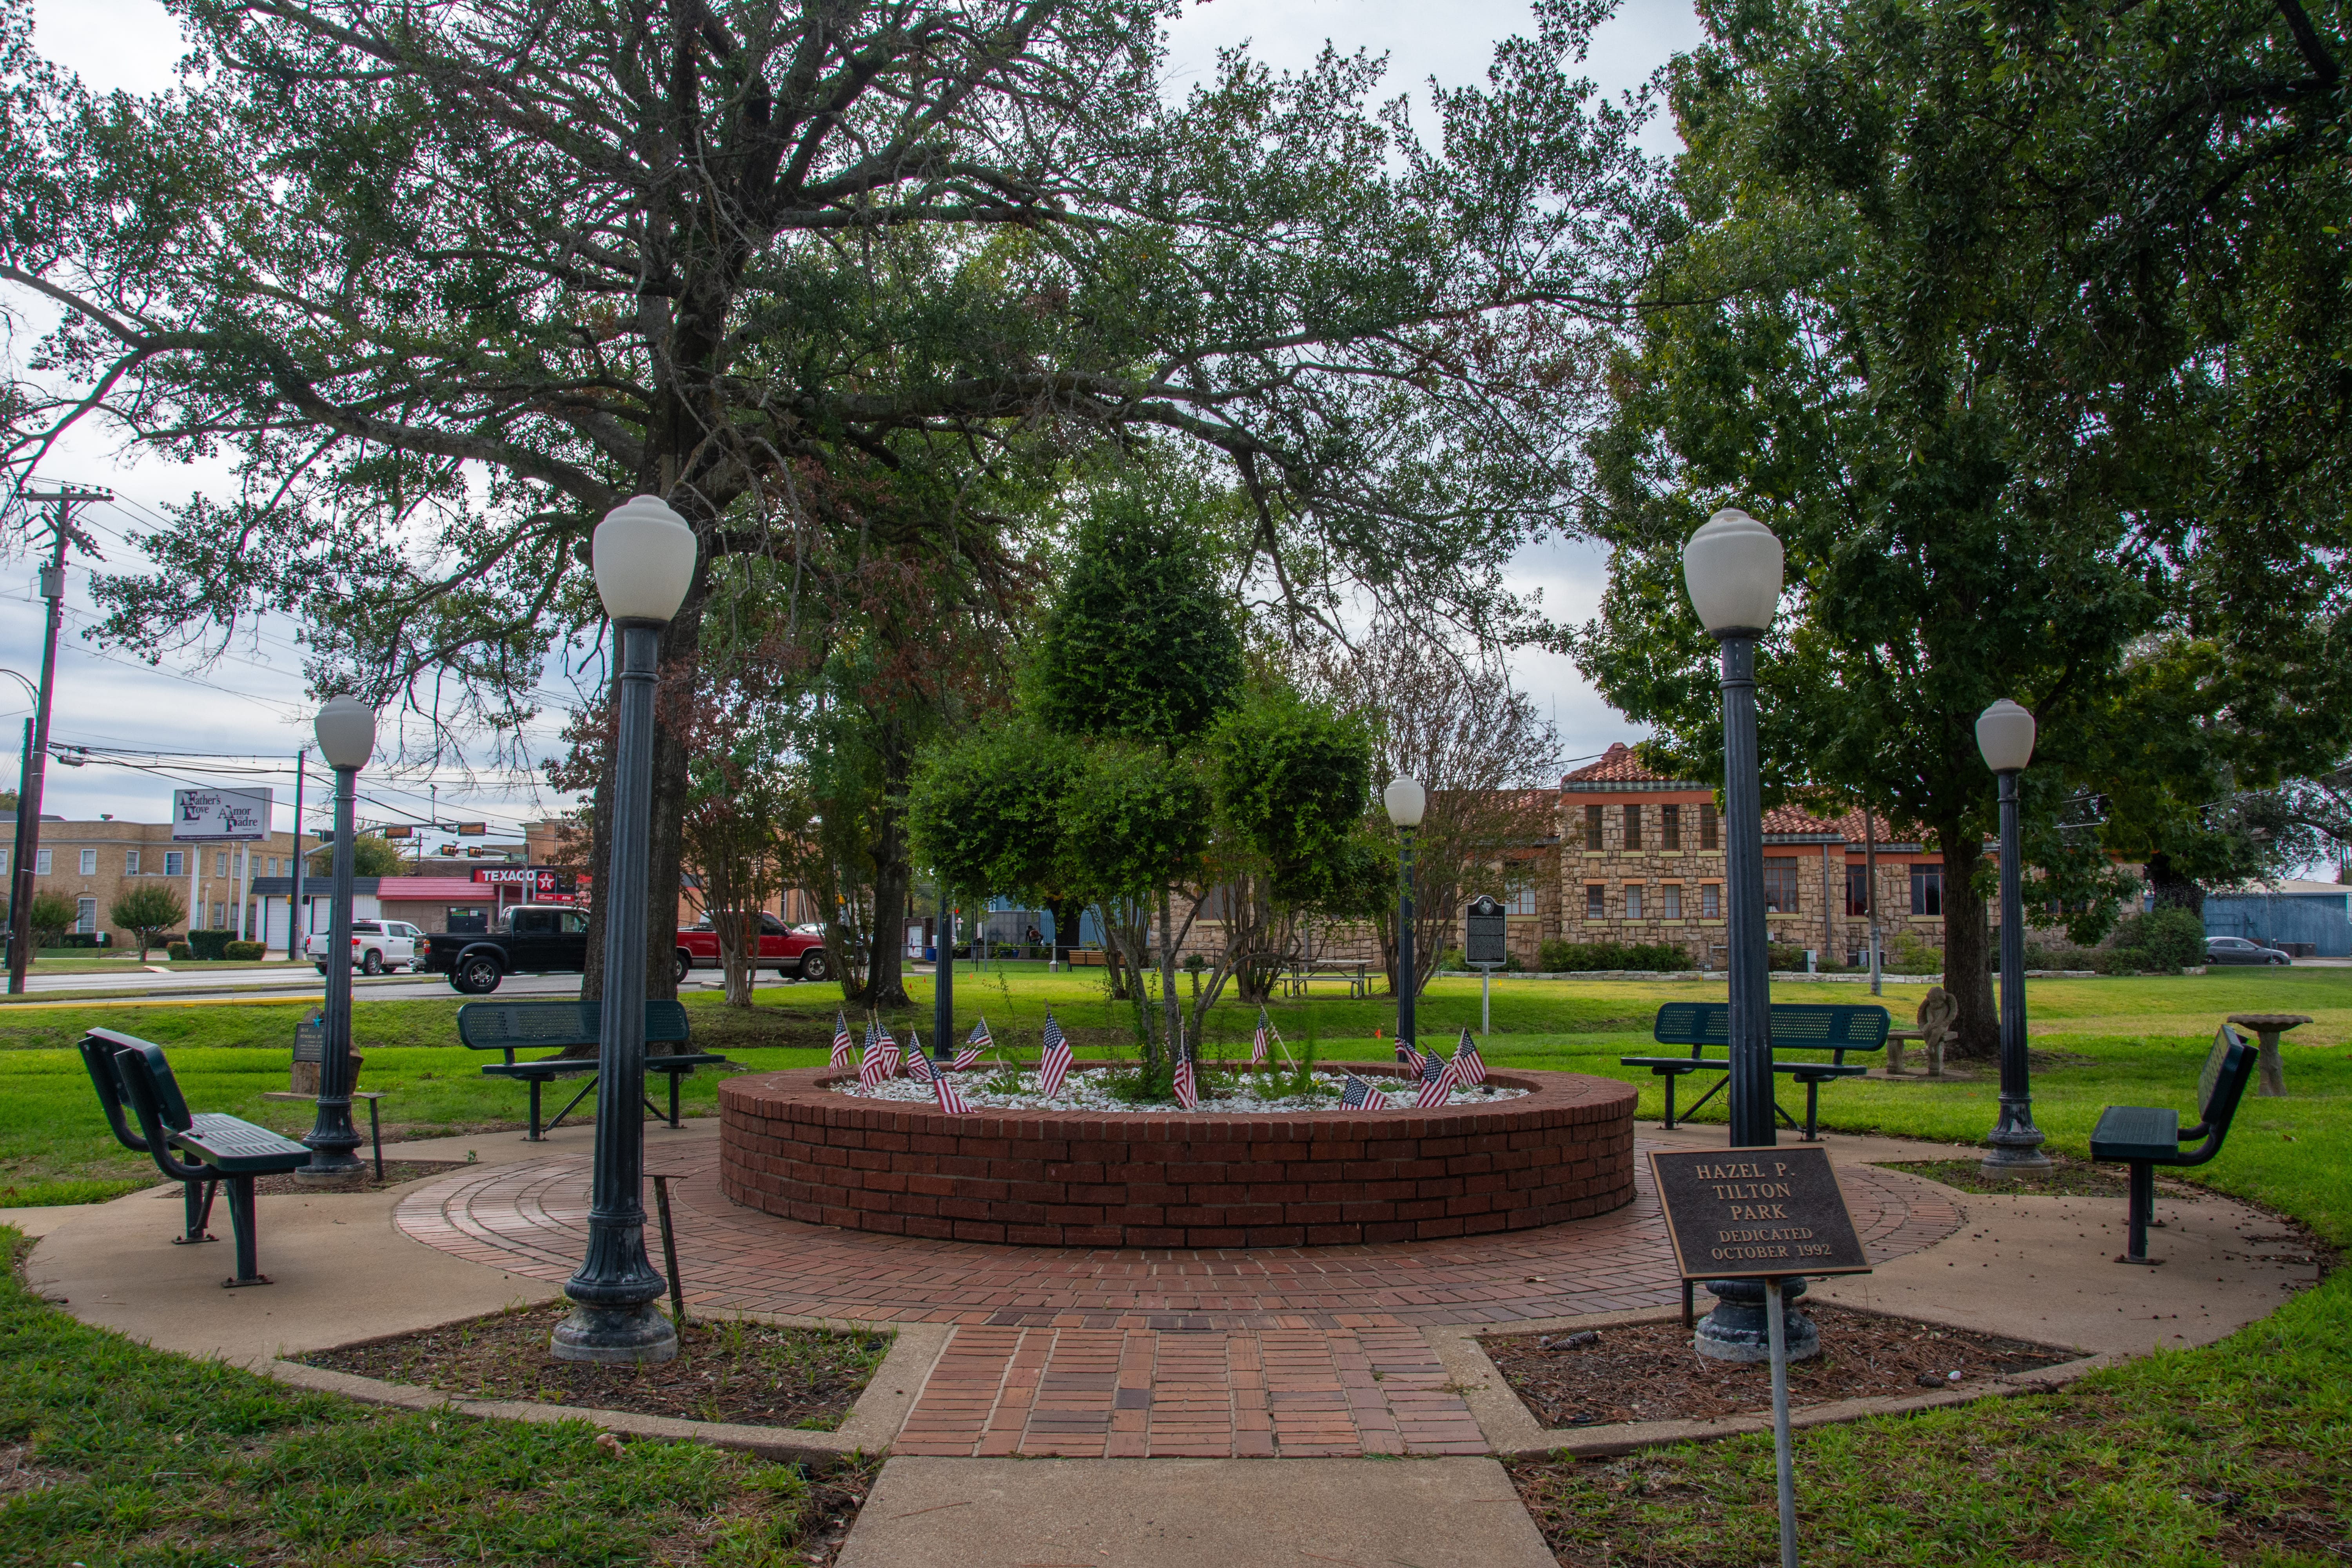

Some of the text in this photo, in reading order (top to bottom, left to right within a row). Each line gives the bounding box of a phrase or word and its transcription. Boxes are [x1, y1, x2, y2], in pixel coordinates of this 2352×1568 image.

[180, 791, 221, 806] Father's
[183, 806, 209, 820] Love
[218, 805, 252, 818] Amor
[225, 817, 258, 832] Padre
[483, 870, 534, 881] TEXACO
[1696, 1163, 1795, 1179] HAZEL P.
[1713, 1183, 1791, 1200] TILTON
[1730, 1204, 1788, 1221] PARK
[1719, 1228, 1813, 1242] DEDICATED
[1712, 1244, 1832, 1259] OCTOBER 1992
